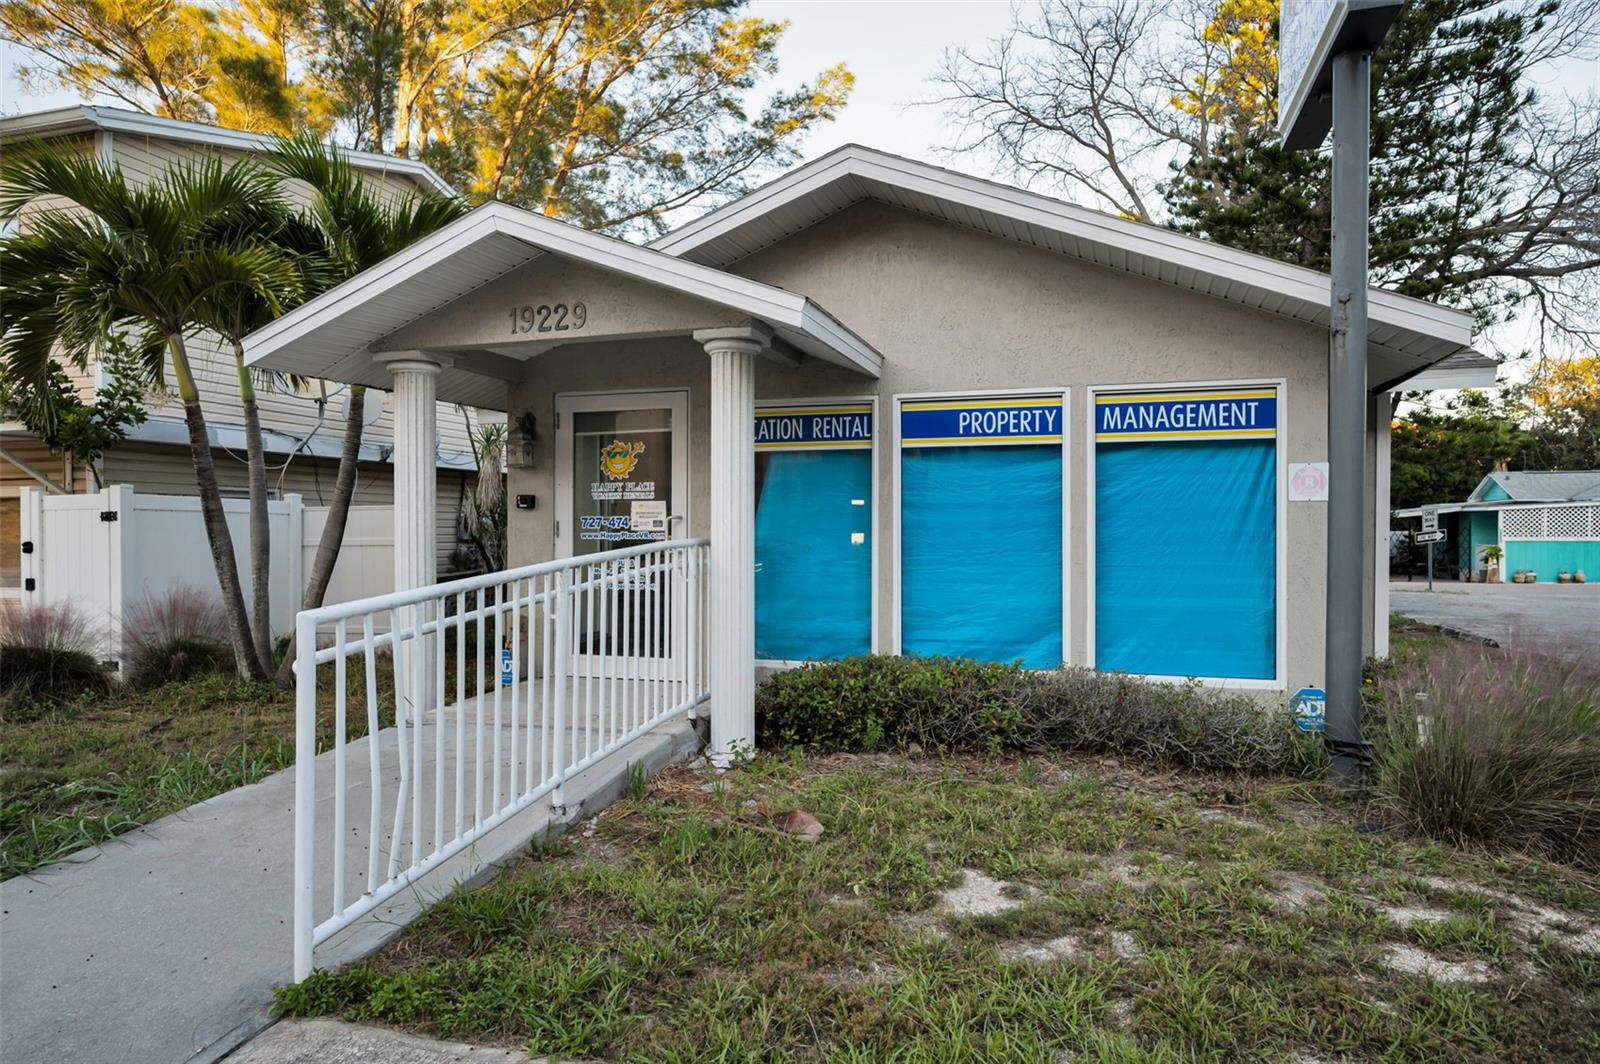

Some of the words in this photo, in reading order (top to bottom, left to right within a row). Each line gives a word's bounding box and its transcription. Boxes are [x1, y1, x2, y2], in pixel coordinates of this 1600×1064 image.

[508, 302, 587, 334] 19229
[812, 416, 872, 439] RENTAL
[959, 409, 1057, 434] PROPERTY
[1103, 402, 1259, 430] MANAGEMENT
[581, 516, 632, 529] 727-474
